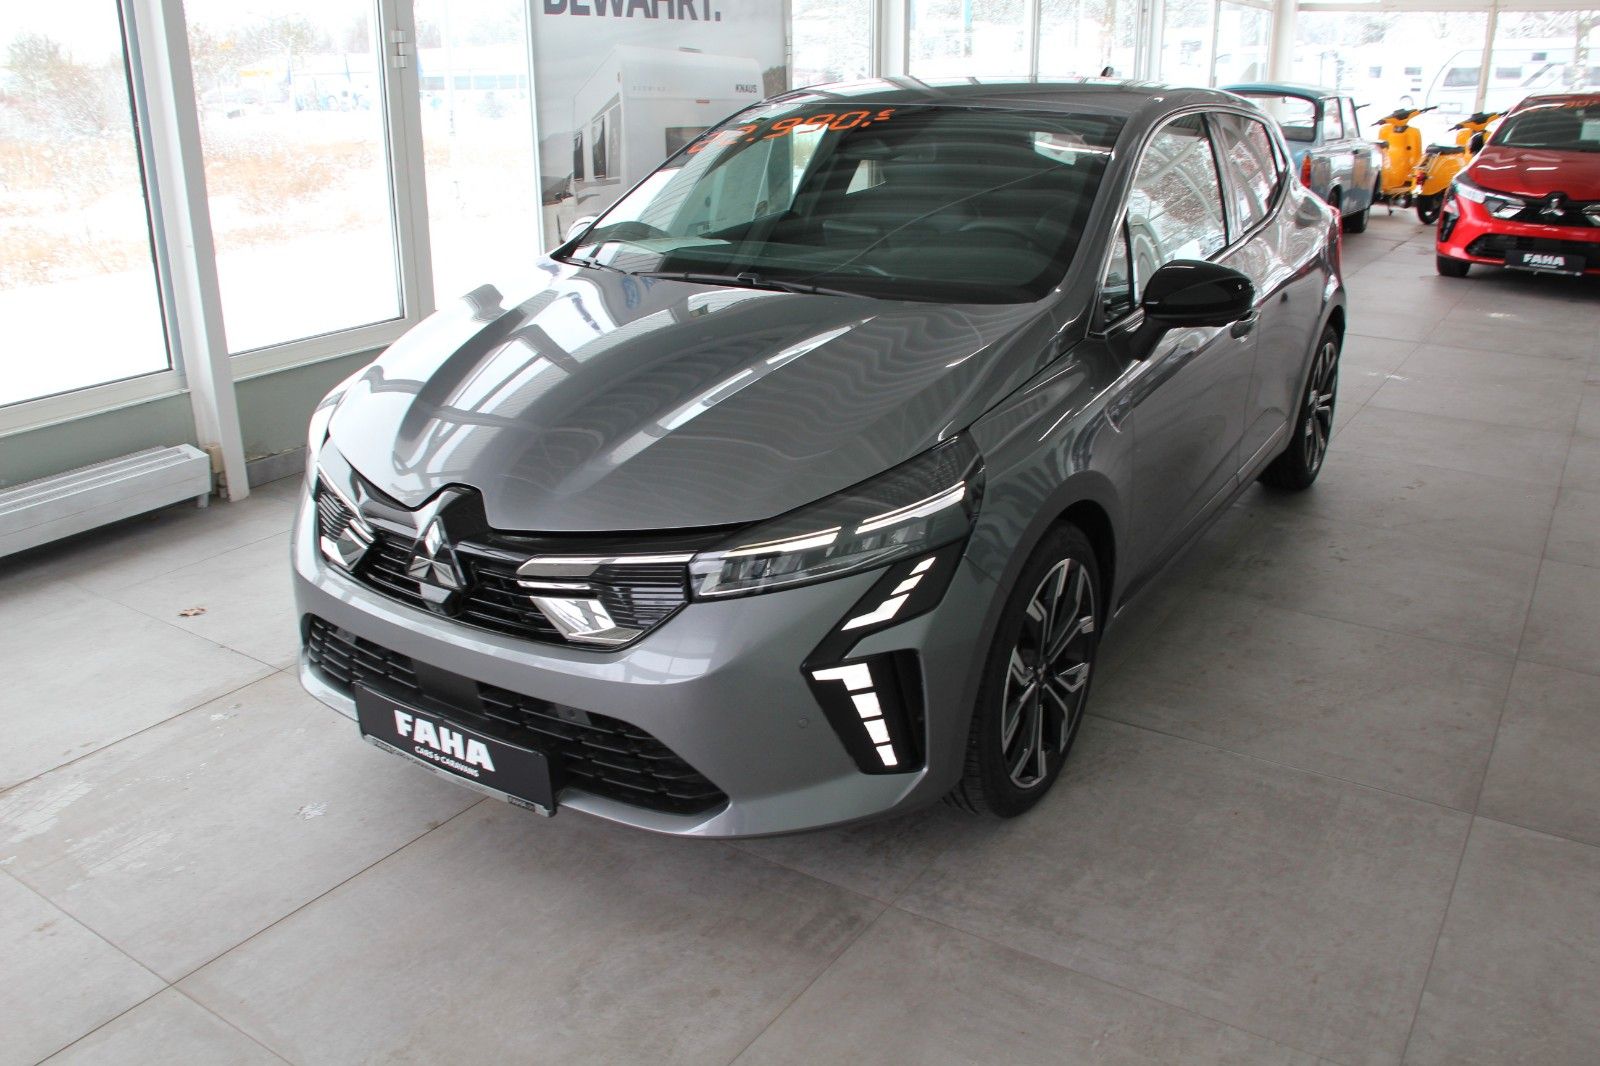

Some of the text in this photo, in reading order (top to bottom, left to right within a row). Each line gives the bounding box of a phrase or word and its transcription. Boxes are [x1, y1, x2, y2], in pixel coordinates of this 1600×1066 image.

[735, 83, 758, 94] KNAUS
[394, 709, 496, 773] FAHA
[414, 745, 434, 759] CARS
